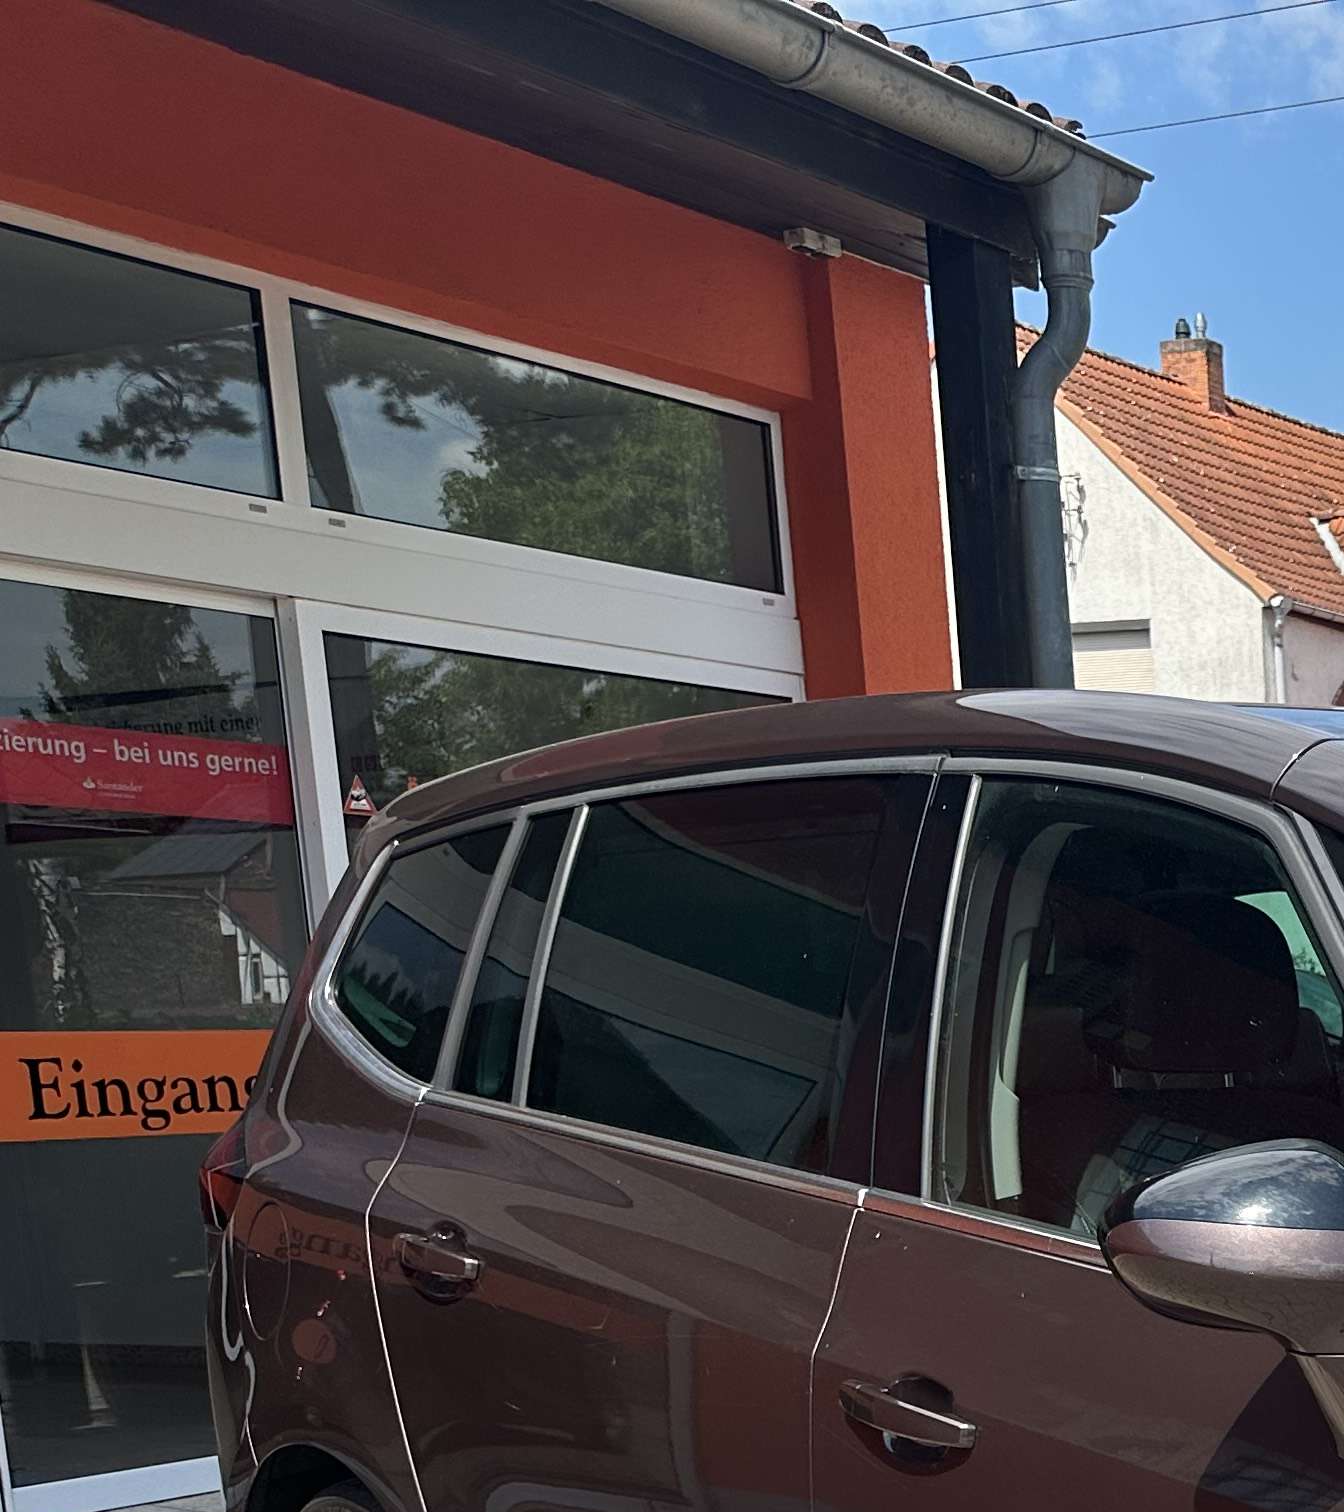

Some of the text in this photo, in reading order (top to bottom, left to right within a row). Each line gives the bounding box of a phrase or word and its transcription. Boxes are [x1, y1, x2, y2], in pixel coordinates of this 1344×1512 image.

[113, 739, 150, 763] bei
[159, 750, 199, 768] uns
[206, 755, 278, 776] gerne!
